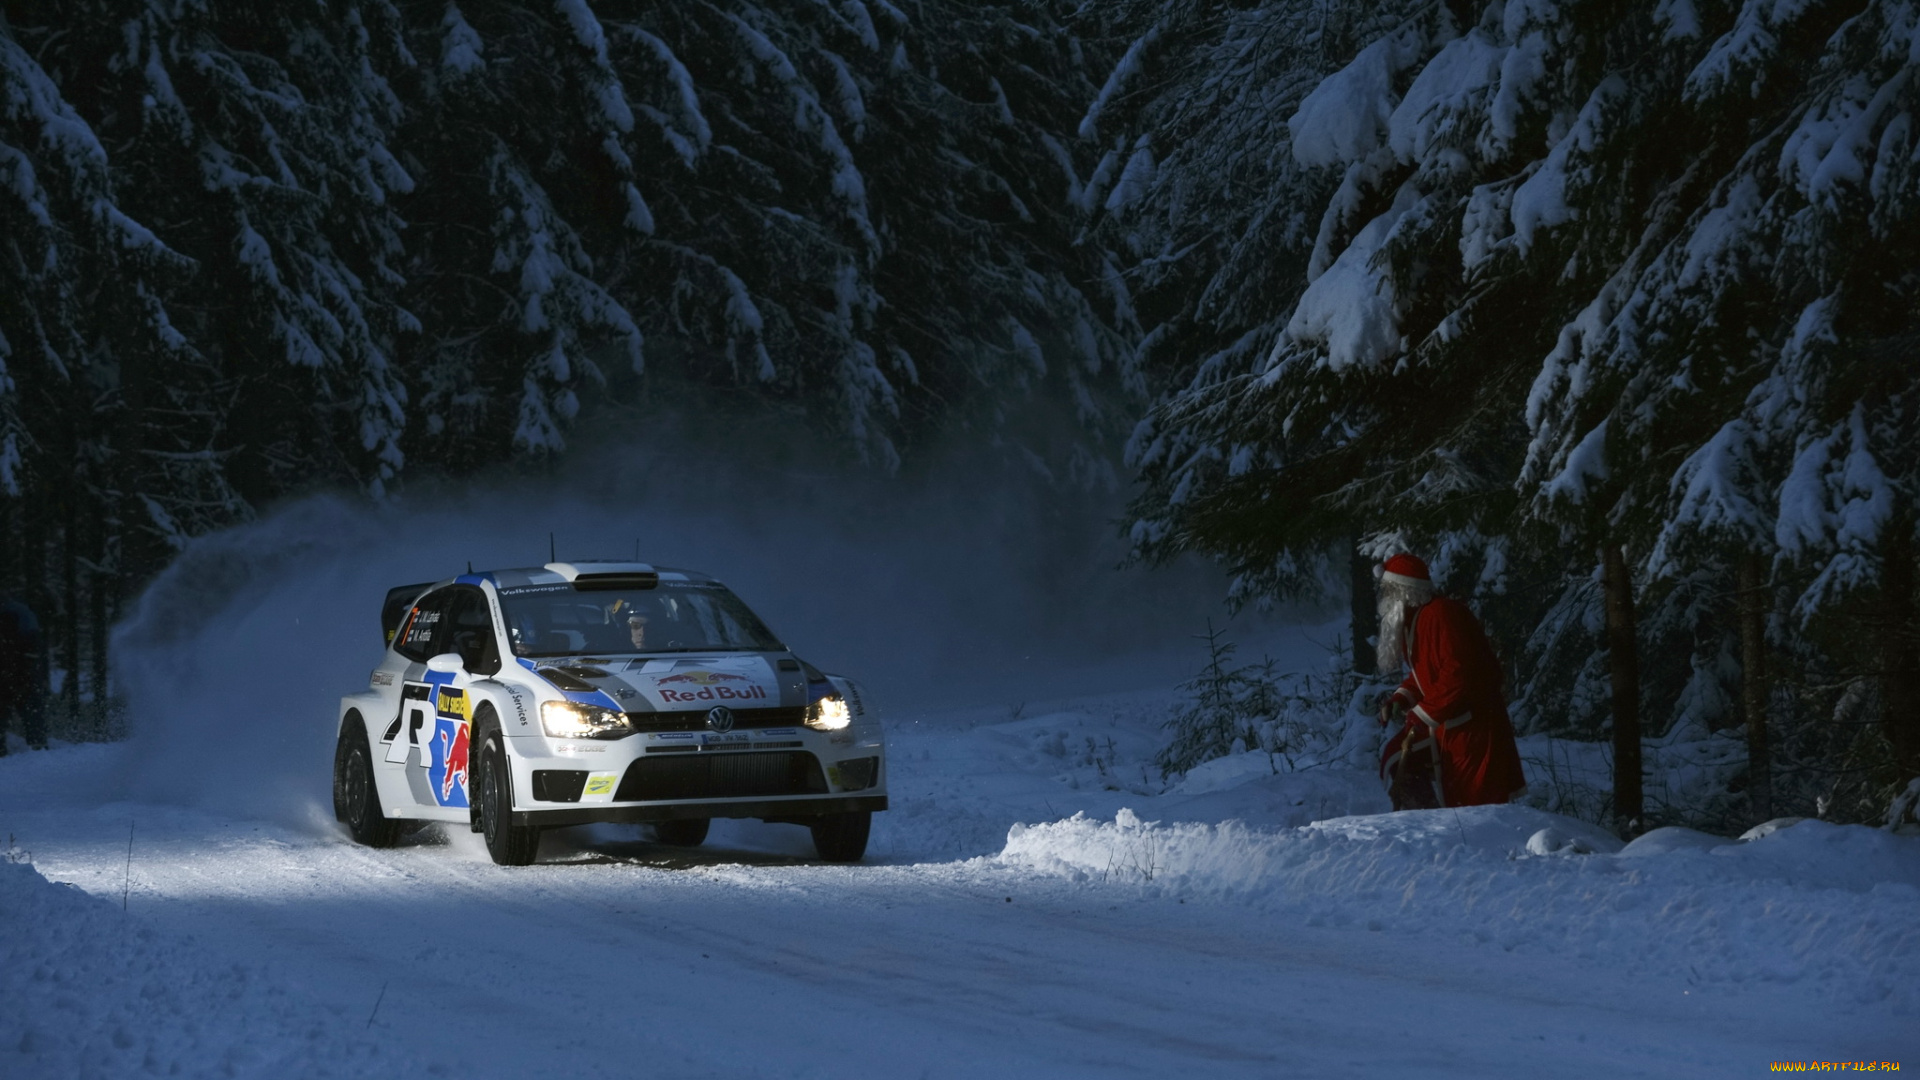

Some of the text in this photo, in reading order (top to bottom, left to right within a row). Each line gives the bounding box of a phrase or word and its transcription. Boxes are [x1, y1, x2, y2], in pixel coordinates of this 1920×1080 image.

[501, 586, 568, 595] Volkswagen
[658, 685, 767, 703] Red Bull
[512, 694, 529, 727] Services
